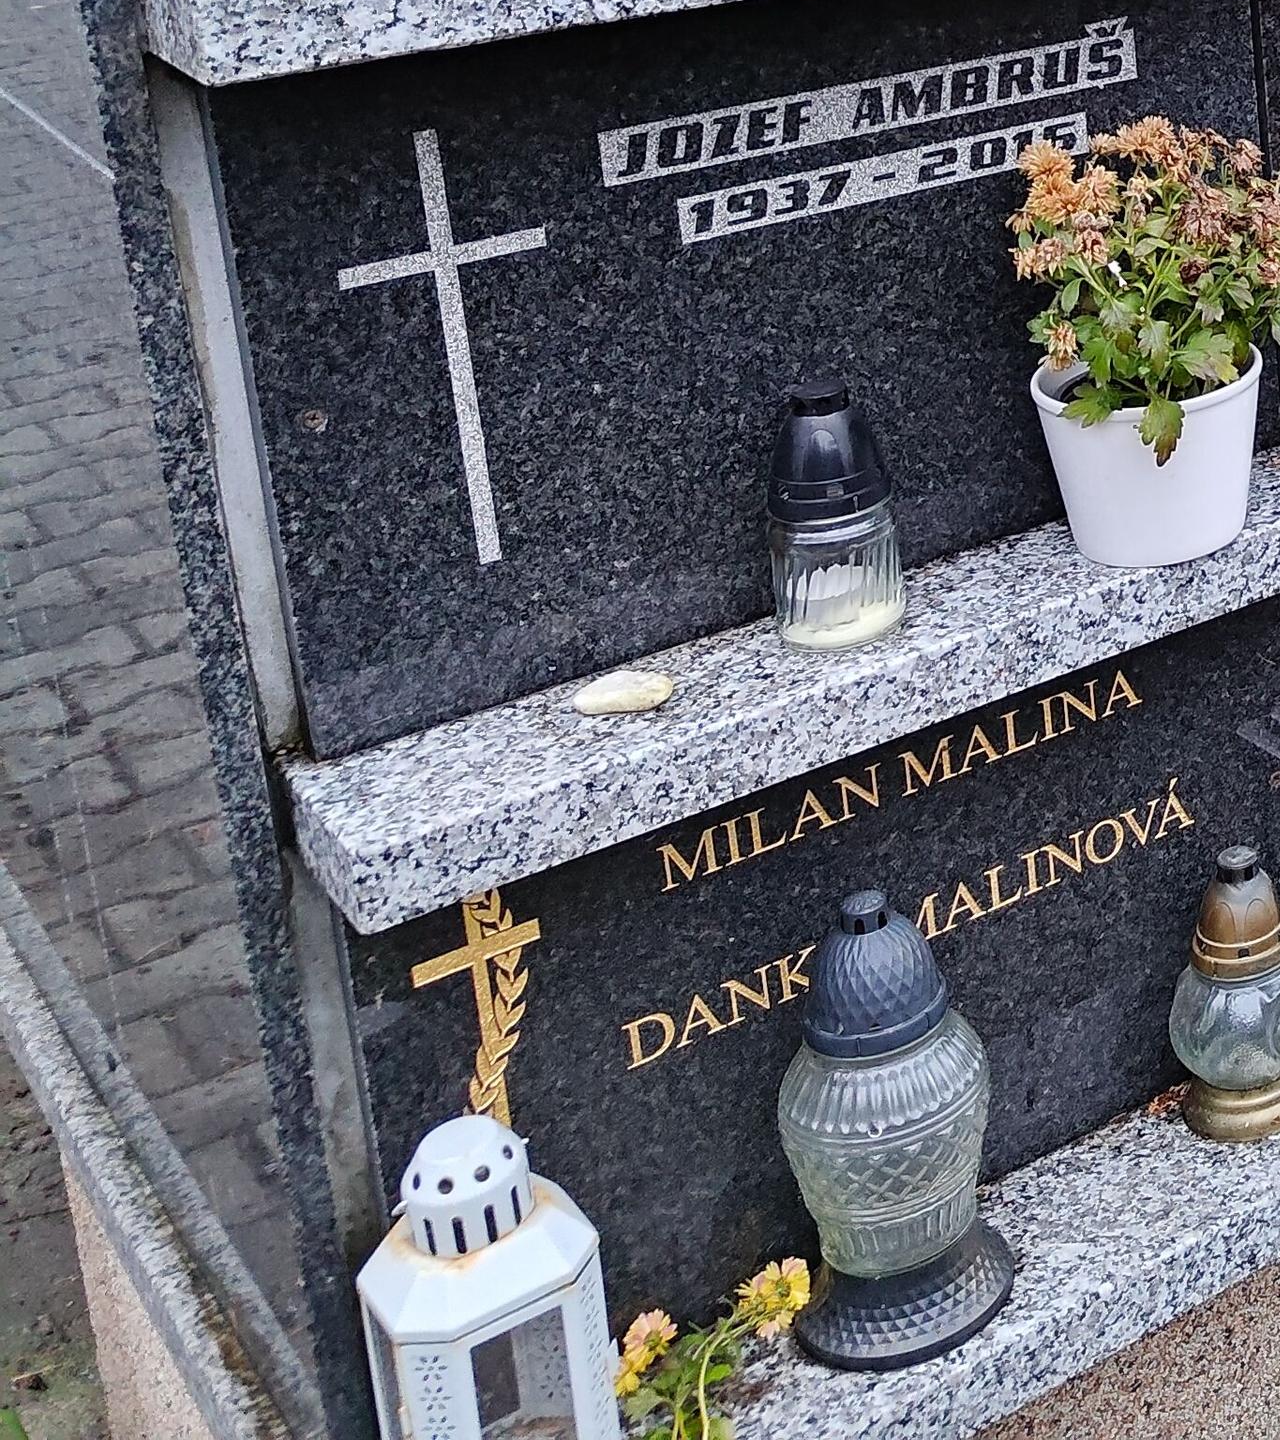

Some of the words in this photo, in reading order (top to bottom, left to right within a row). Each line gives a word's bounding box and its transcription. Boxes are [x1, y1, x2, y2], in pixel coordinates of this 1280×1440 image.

[616, 99, 813, 179] JOZEF
[851, 22, 1126, 131] AMBRUŠ
[686, 169, 851, 236] 1937
[655, 762, 881, 894] MILAN
[896, 669, 1144, 799] MALINA
[620, 945, 817, 1072] DANK
